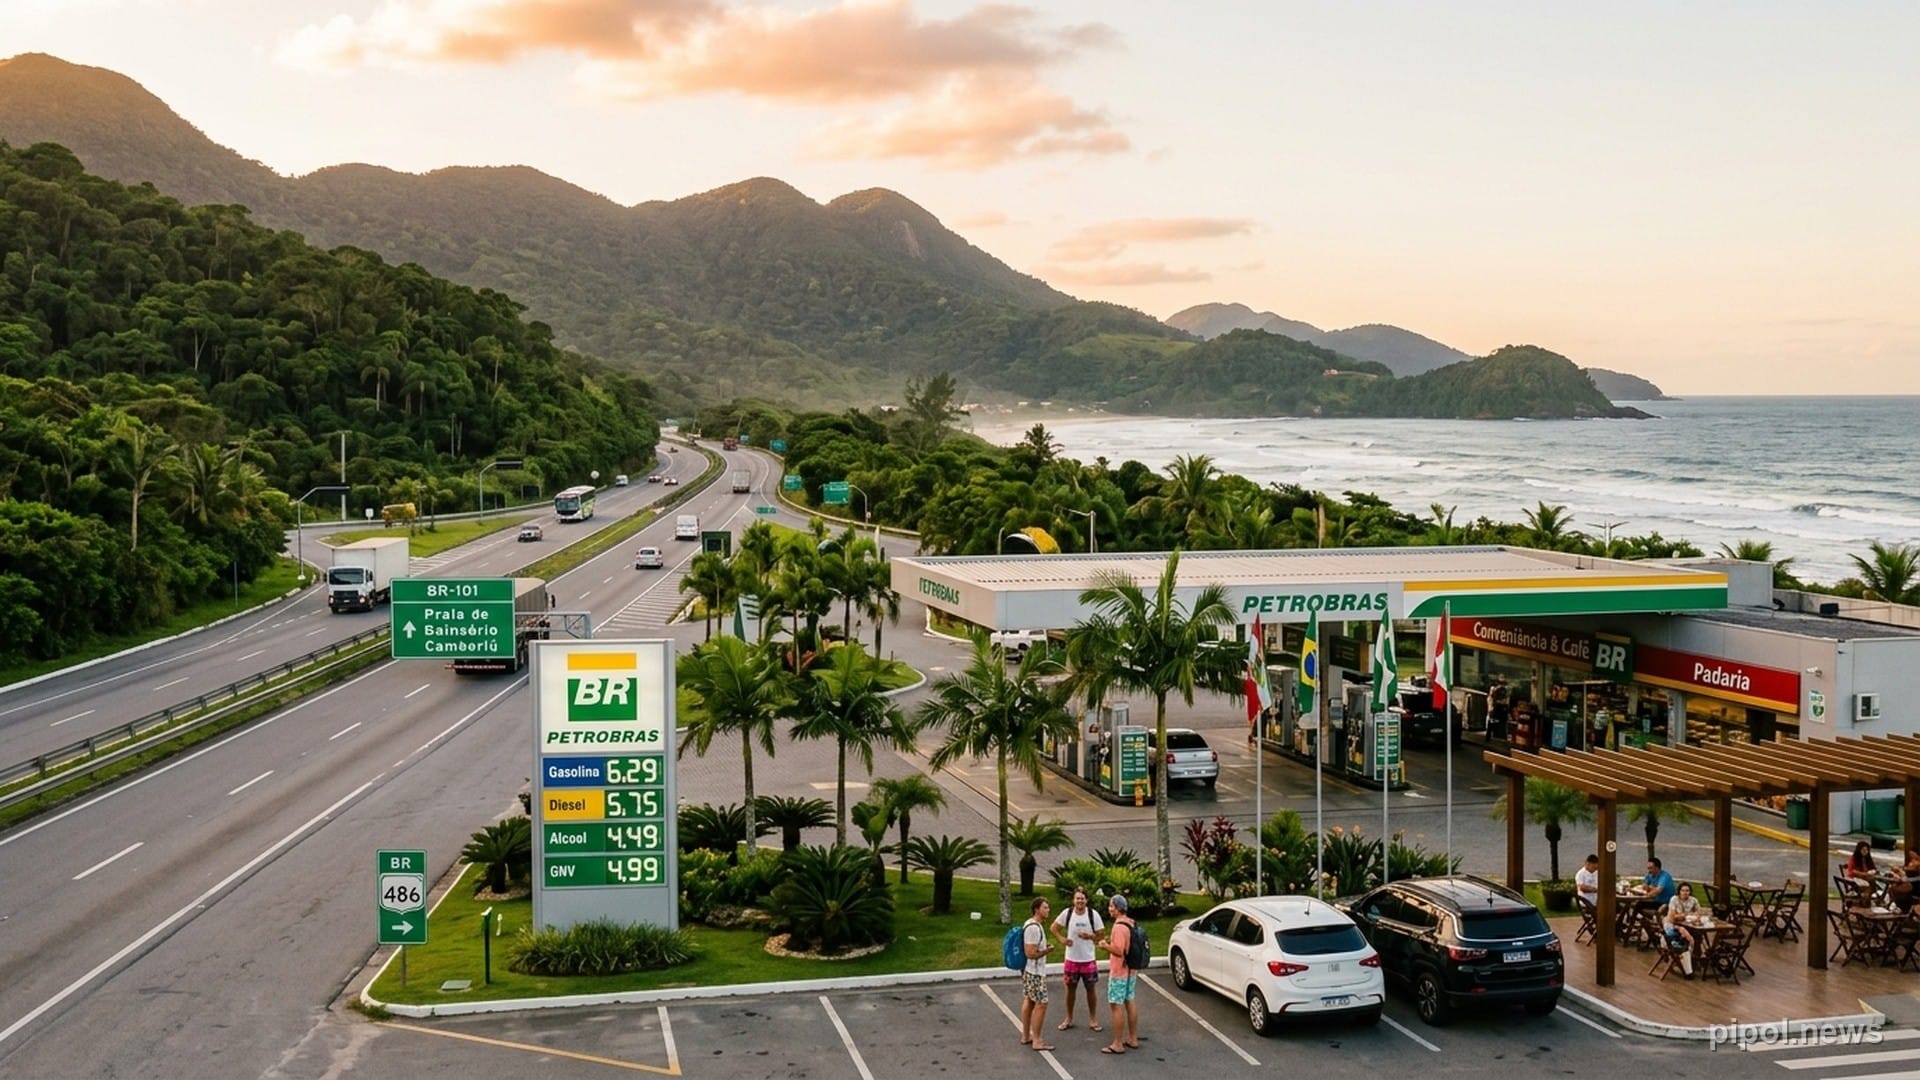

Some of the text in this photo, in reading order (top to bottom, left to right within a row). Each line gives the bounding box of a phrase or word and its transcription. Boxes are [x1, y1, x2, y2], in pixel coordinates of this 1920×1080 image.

[1242, 593, 1388, 613] PETROBRAS
[471, 609, 489, 620] de
[1596, 643, 1626, 671] BR
[1693, 662, 1751, 691] Padaria
[573, 677, 631, 705] BR
[546, 730, 660, 744] PETROBRAS
[548, 758, 658, 784] Gasolina 6.29
[549, 799, 586, 812] Diesel
[549, 824, 659, 850] Alcool 4.49
[390, 857, 412, 870] BR
[550, 865, 576, 878] GNV
[383, 885, 421, 903] 486
